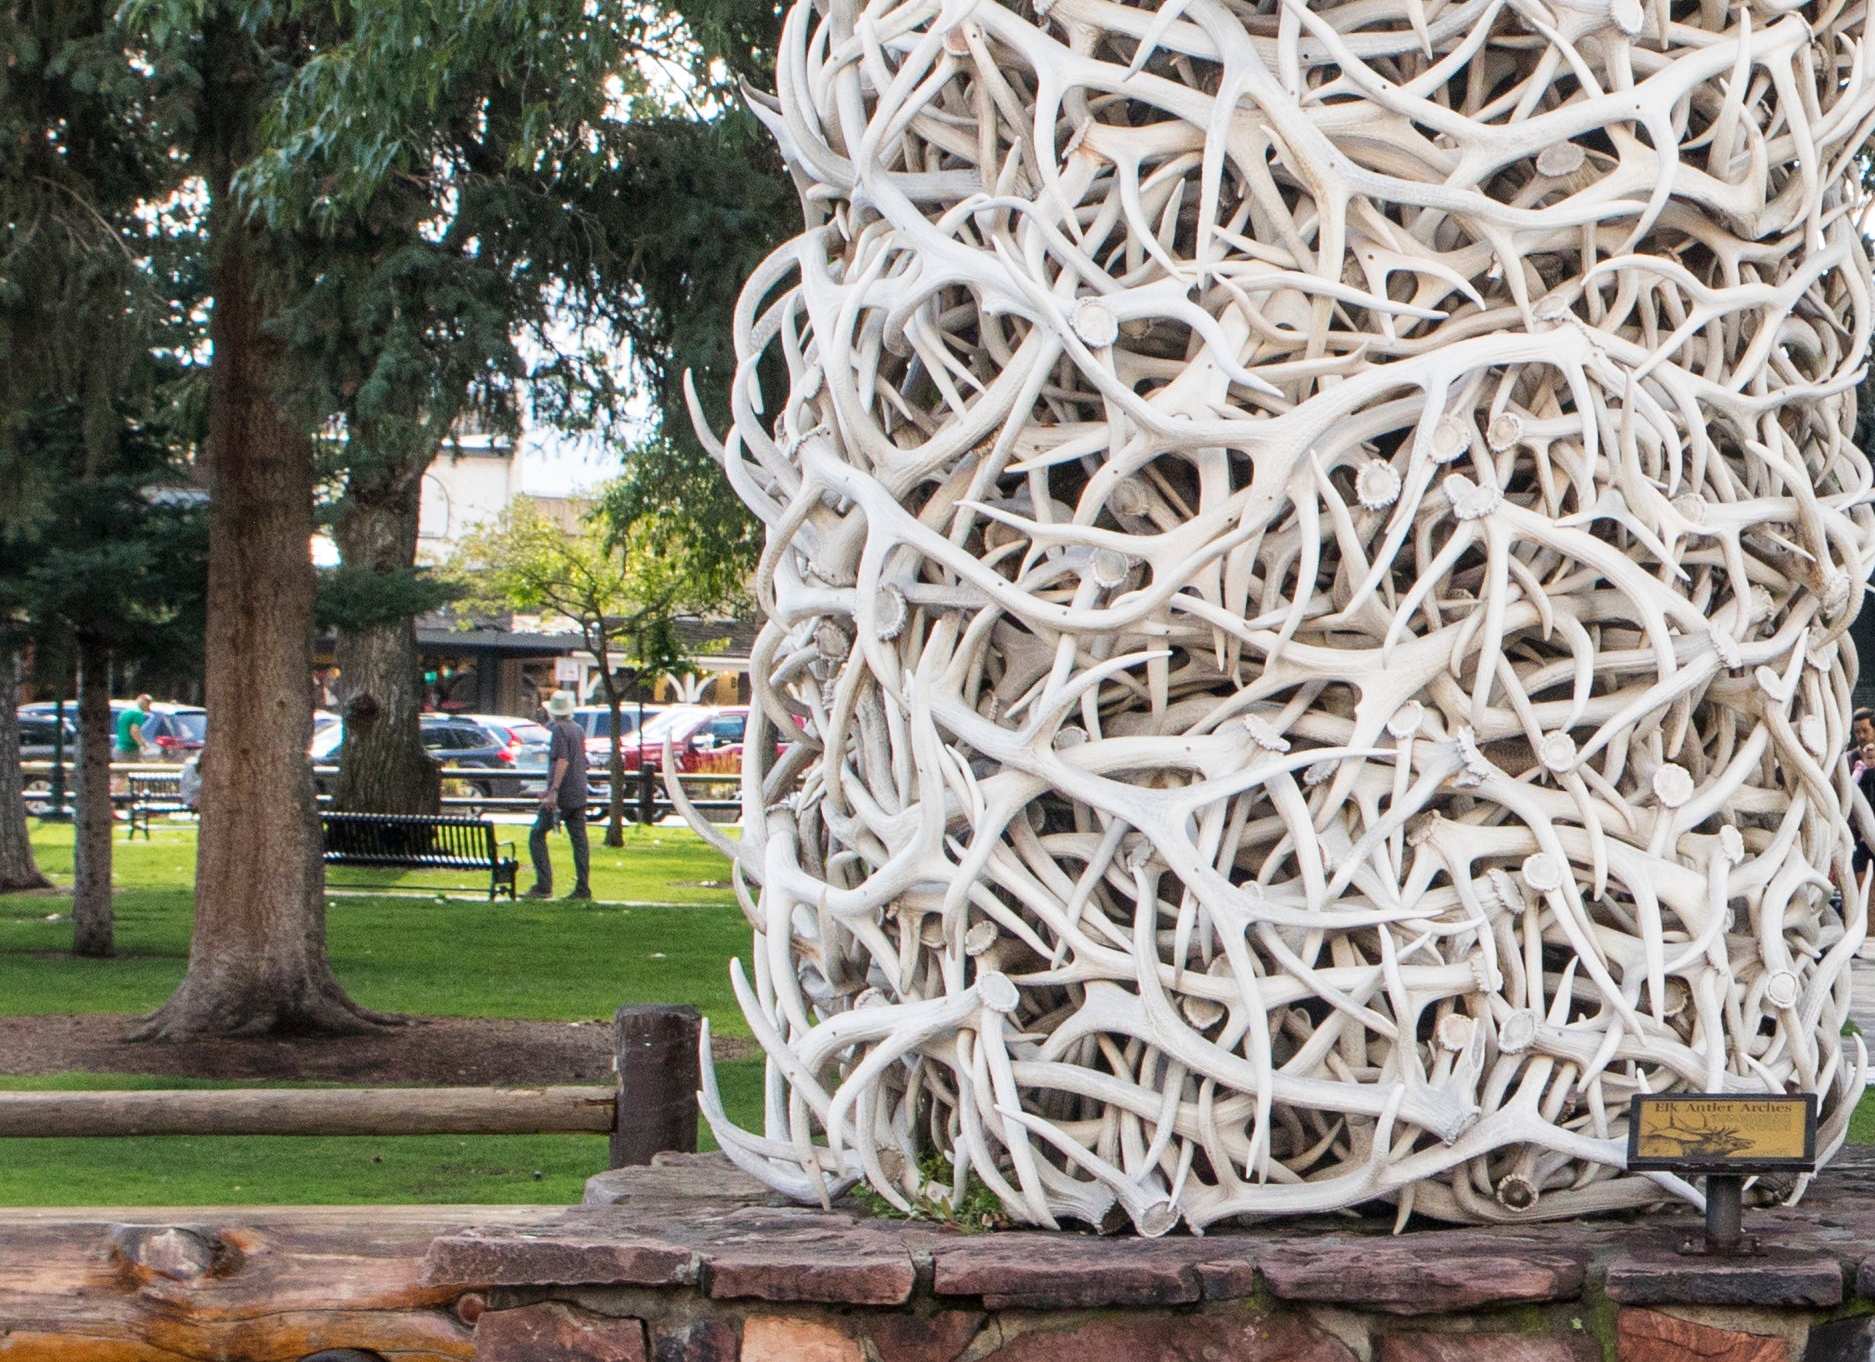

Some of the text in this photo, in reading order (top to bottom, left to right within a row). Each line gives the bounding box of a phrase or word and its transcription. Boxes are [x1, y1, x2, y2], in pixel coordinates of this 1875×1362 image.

[1654, 1102, 1793, 1113] Elk Antler Arches
